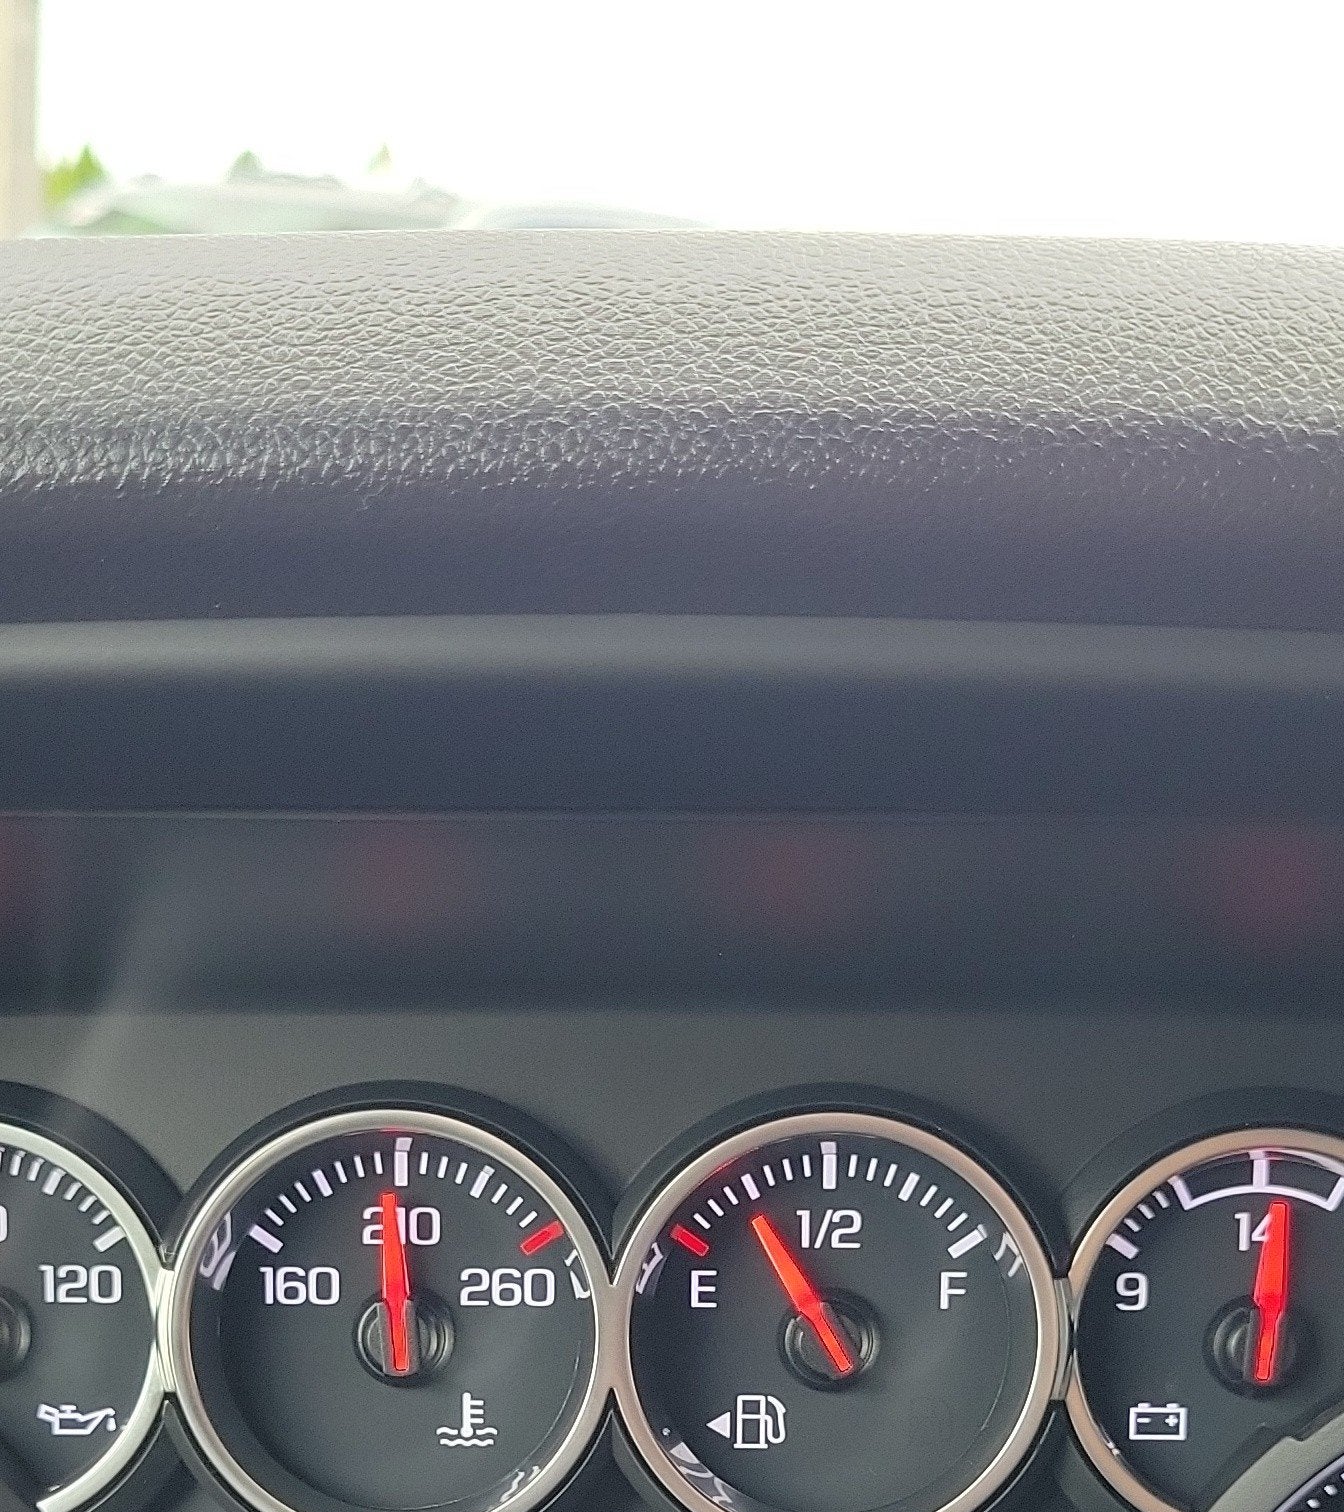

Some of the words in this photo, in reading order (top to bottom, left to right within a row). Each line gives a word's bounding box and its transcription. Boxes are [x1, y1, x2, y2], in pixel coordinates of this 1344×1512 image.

[796, 1209, 862, 1249] 1/2
[38, 1264, 122, 1304] 120
[259, 1266, 340, 1306] 160
[460, 1267, 555, 1307] 260
[690, 1270, 718, 1308] E
[939, 1271, 968, 1310] F
[1115, 1272, 1148, 1311] 9
